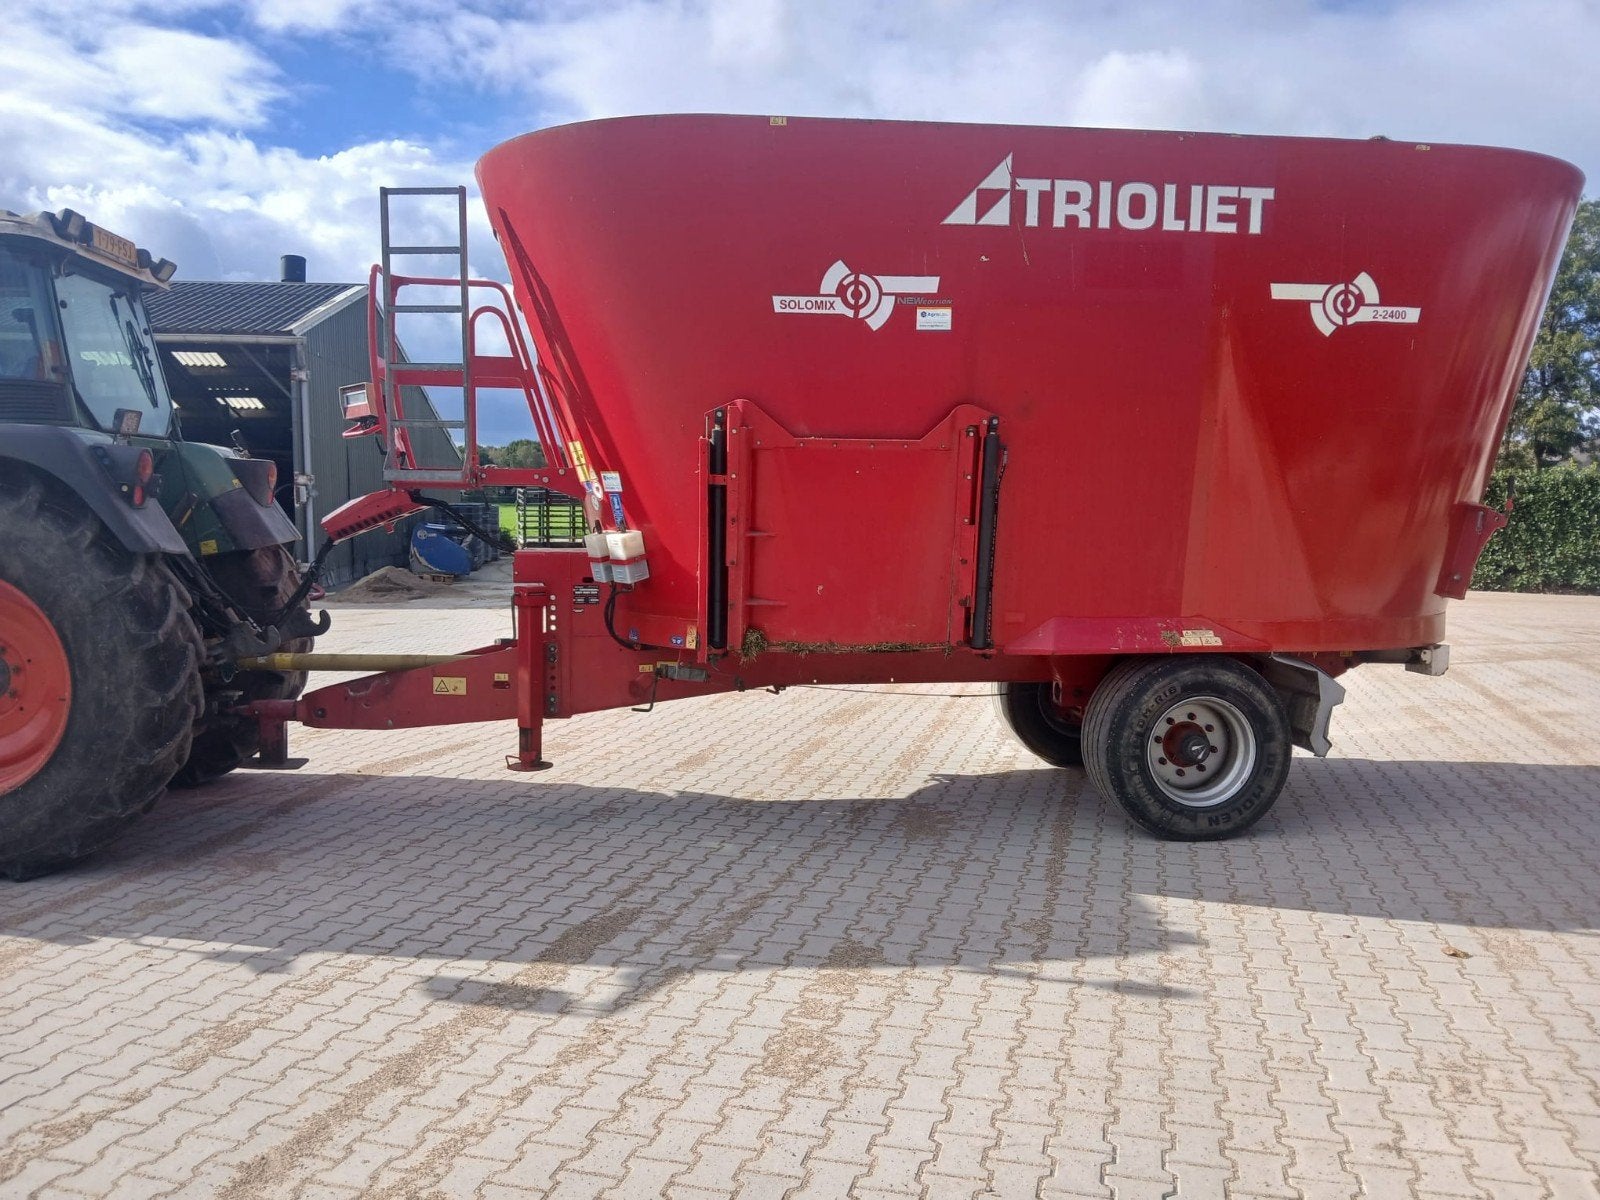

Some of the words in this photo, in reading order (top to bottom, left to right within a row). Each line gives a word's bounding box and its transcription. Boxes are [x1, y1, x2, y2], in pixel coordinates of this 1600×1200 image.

[1015, 178, 1275, 234] TRIOLIET
[779, 299, 836, 311] SOLOMIX
[1372, 309, 1407, 320] 2-2400
